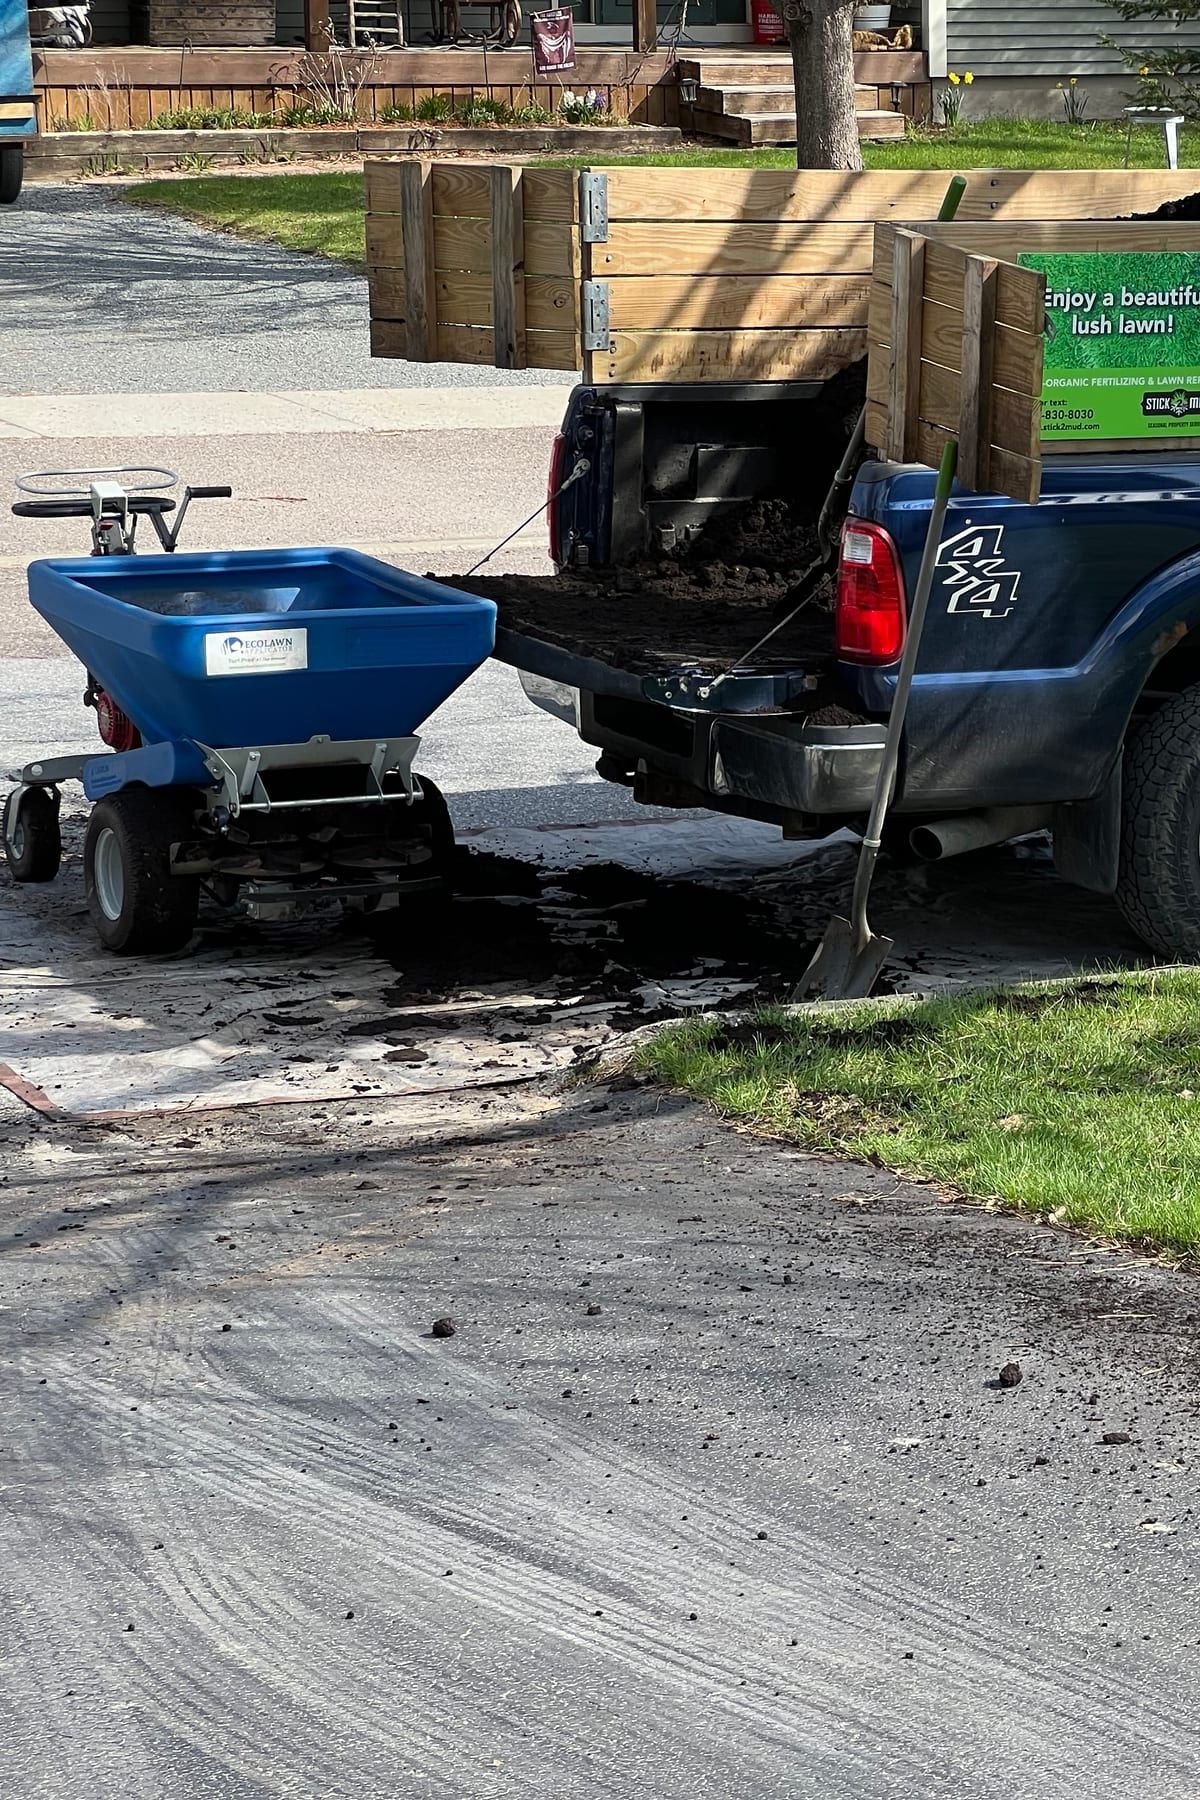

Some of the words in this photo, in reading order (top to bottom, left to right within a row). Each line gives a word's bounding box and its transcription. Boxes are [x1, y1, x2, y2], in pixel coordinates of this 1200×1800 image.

[1044, 288, 1096, 312] Enjoy
[1103, 293, 1114, 306] a
[1072, 314, 1112, 334] lush
[1119, 314, 1173, 334] lawn!
[1091, 377, 1145, 386] FERTILIZING
[1147, 377, 1155, 385] &
[1157, 376, 1184, 385] LAWN
[1146, 397, 1171, 410] STICK
[245, 638, 293, 649] ECOLAWN
